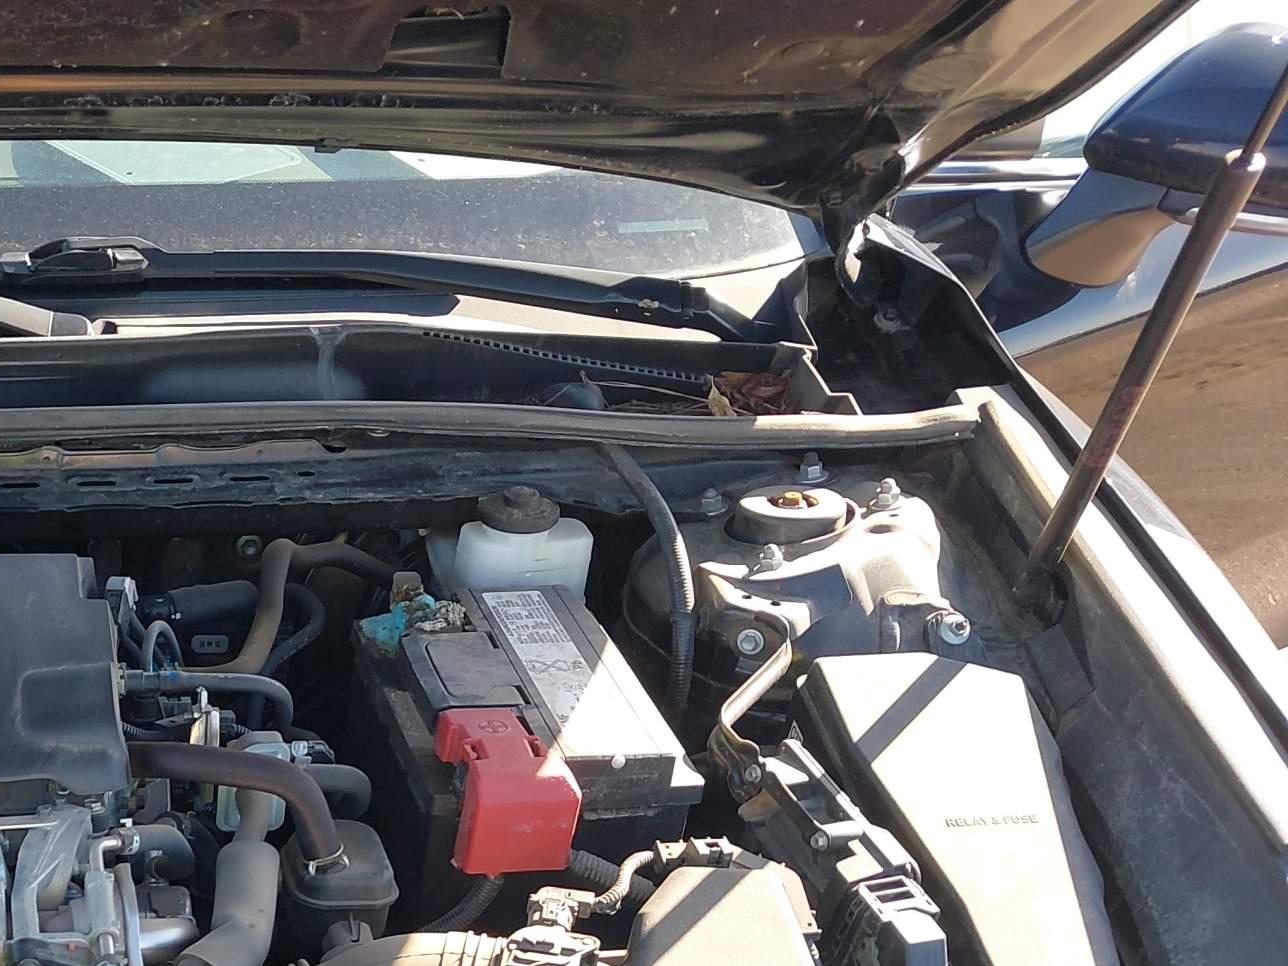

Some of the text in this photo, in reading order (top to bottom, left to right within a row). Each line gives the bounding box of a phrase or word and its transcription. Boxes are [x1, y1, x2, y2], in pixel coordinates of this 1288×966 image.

[944, 815, 1039, 828] RELAY & FUSE
